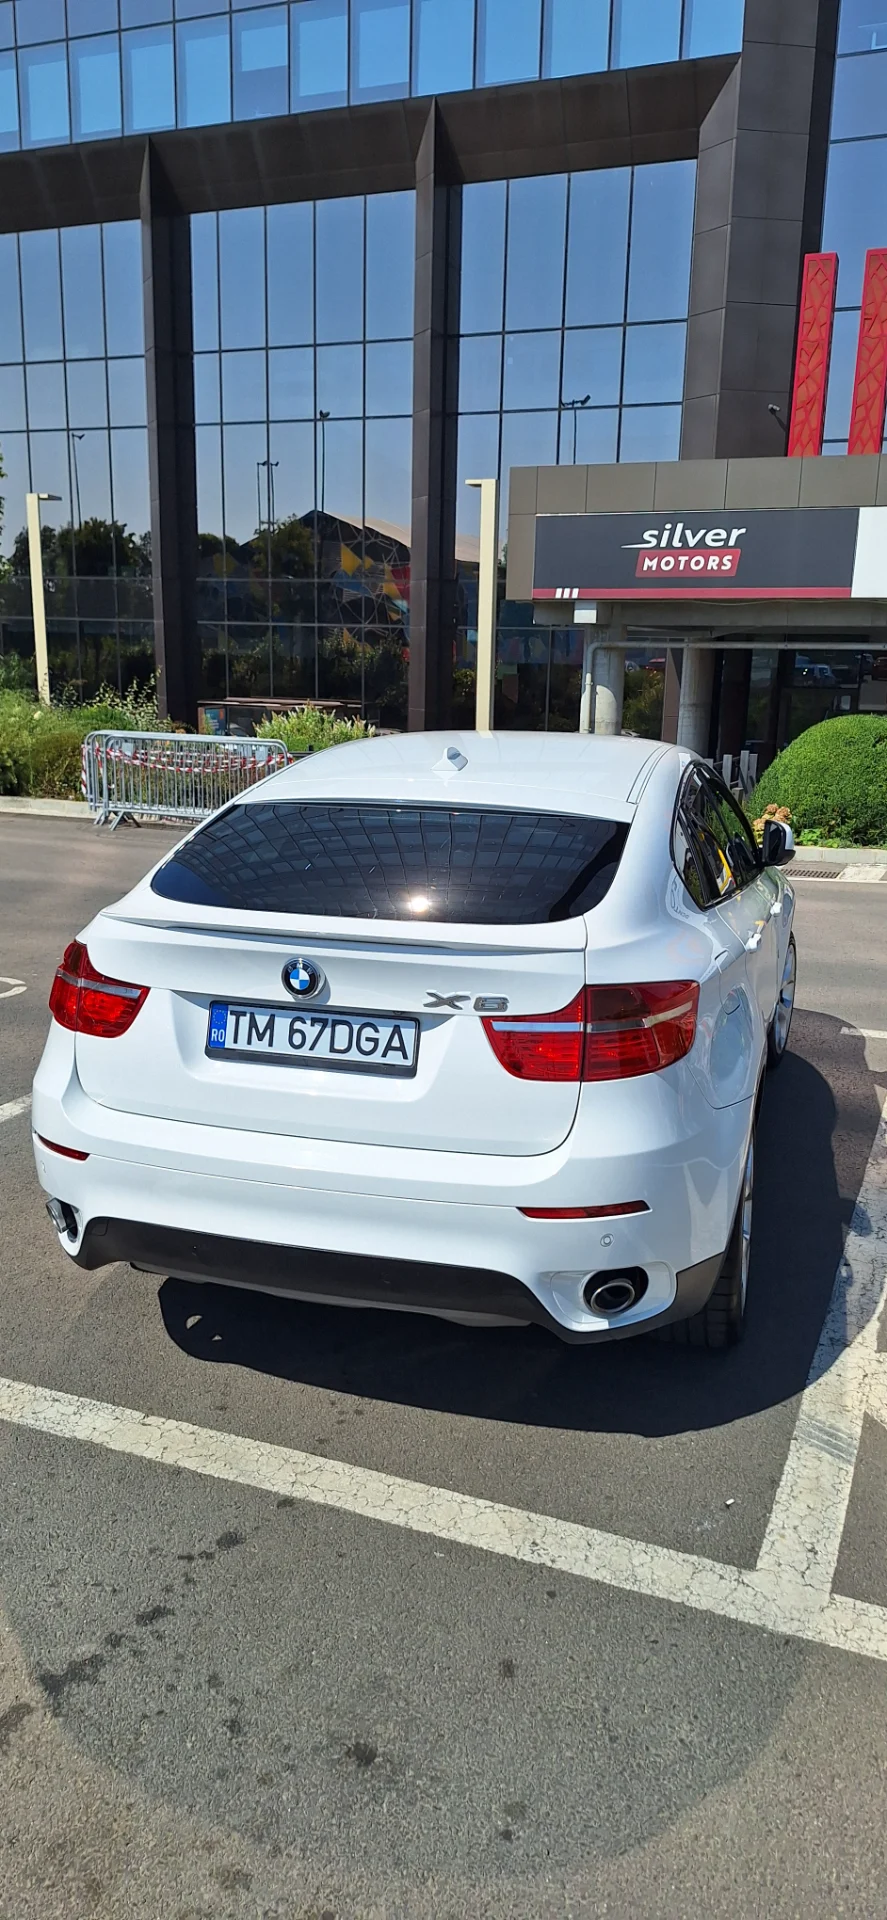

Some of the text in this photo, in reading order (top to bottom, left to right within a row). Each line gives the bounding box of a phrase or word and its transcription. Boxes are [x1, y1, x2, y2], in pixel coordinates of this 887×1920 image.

[621, 522, 747, 549] silver
[642, 554, 733, 572] MOTORS
[287, 962, 314, 975] BMW
[423, 989, 510, 1013] X6
[210, 1028, 226, 1043] RO
[230, 1009, 409, 1060] TM 67DGA
